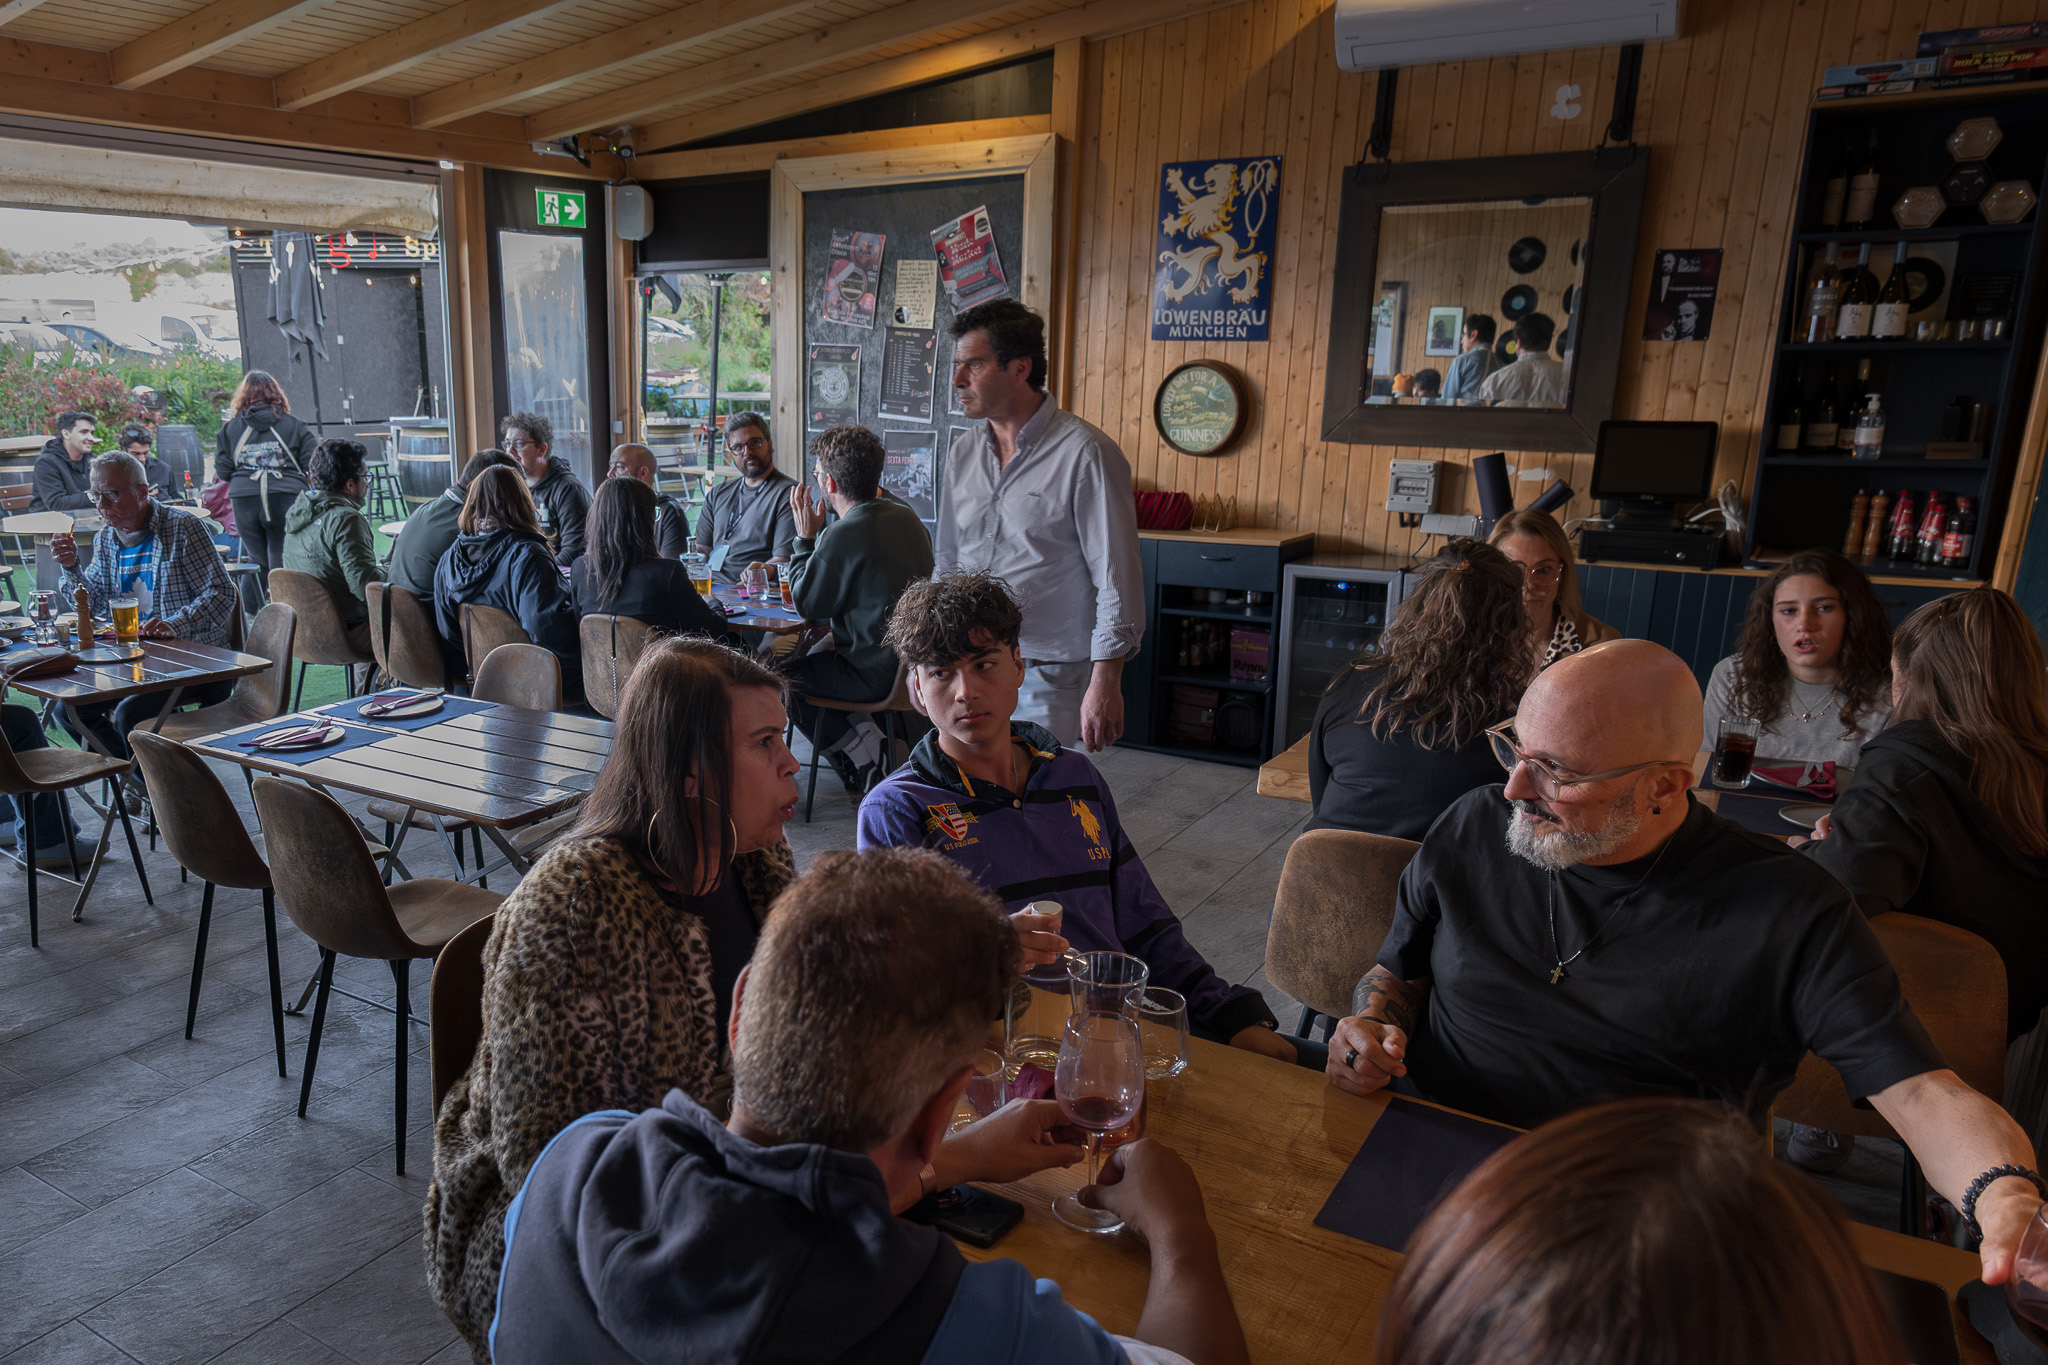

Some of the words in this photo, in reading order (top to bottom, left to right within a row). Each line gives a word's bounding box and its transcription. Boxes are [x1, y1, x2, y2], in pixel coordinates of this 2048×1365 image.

[1953, 58, 1982, 68] ROCK
[1983, 55, 2008, 66] AND
[2010, 52, 2035, 62] POP
[831, 248, 847, 257] Disco
[950, 237, 975, 255] Music
[951, 246, 983, 265] Market
[1154, 308, 1267, 326] LÖWENBRÄU
[1169, 325, 1247, 338] MÜNCHEN
[1162, 385, 1176, 417] LOVELY
[1173, 373, 1189, 389] DAY
[1189, 370, 1207, 382] FOR
[1208, 376, 1217, 388] A
[1169, 428, 1223, 443] GUINNESS
[887, 456, 901, 465] SEXTA
[955, 839, 967, 849] POLO
